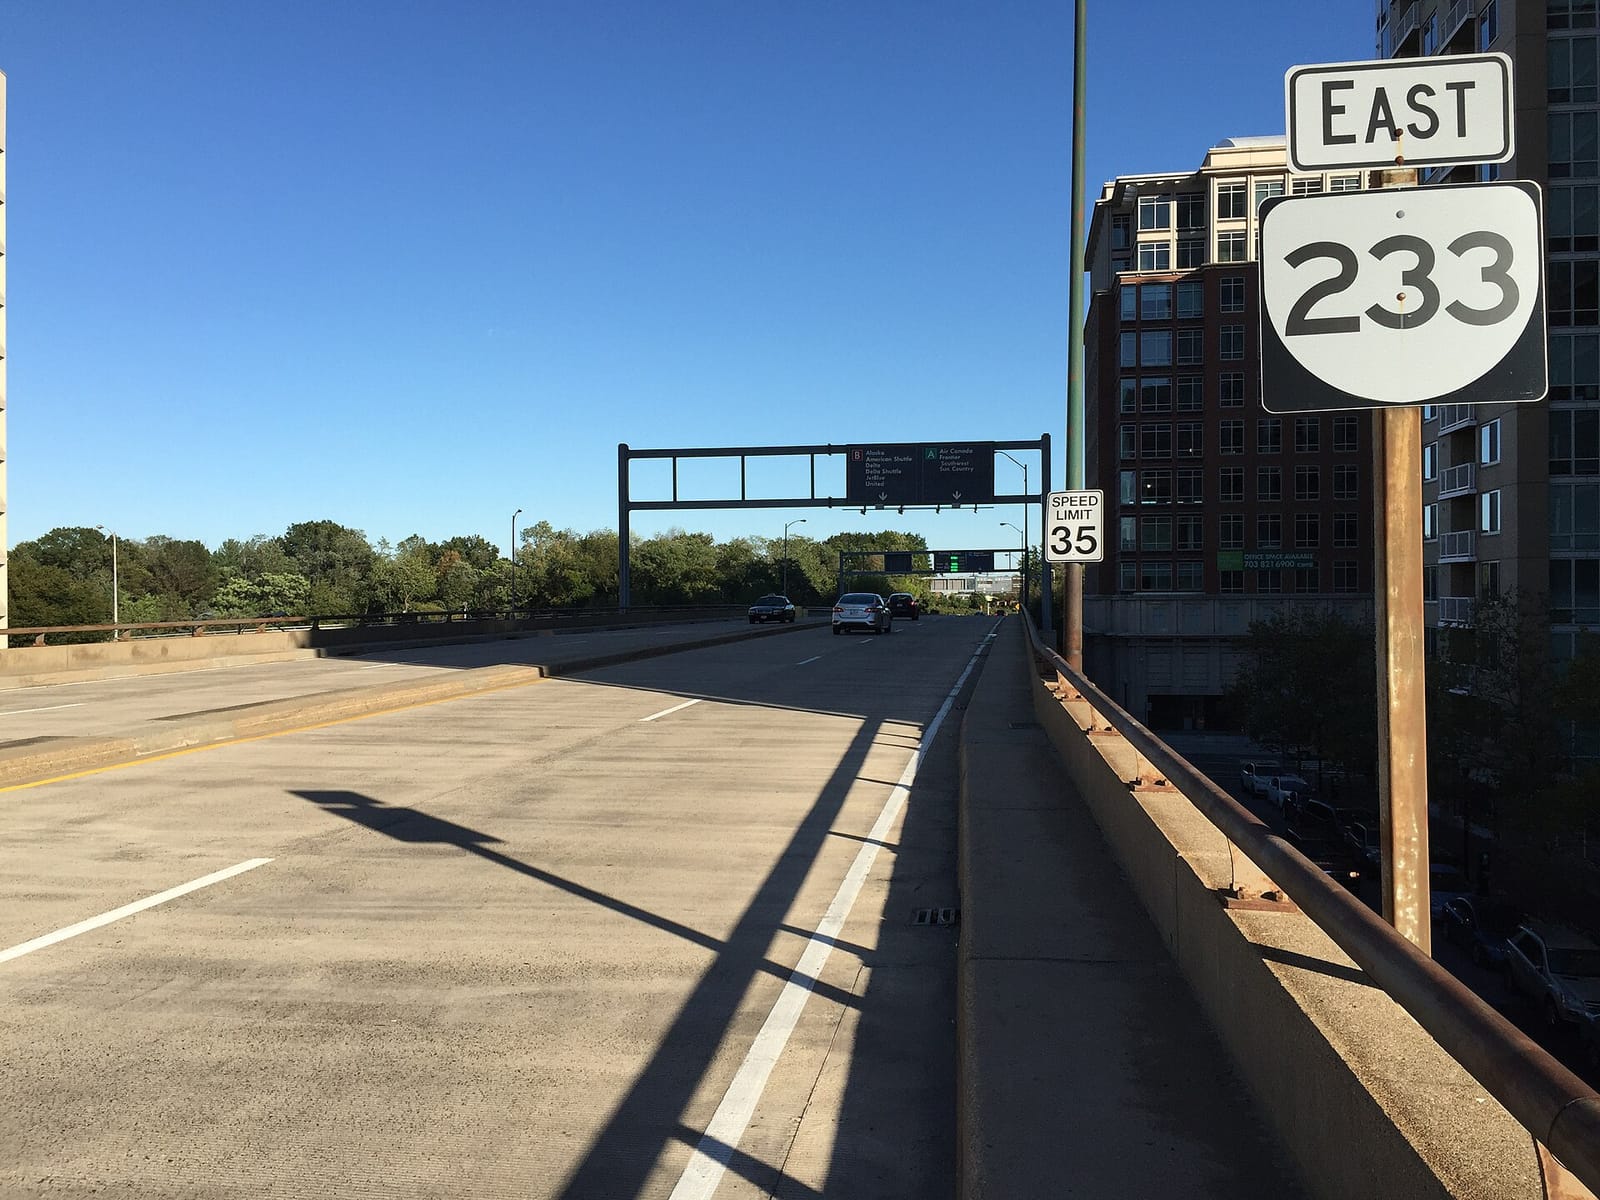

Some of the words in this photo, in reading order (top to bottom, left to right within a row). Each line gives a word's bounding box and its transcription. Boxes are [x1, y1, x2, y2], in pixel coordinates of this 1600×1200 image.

[1322, 80, 1475, 145] EAST
[1283, 230, 1519, 336] 233
[854, 451, 861, 460] B
[927, 450, 935, 458] A
[1052, 495, 1098, 507] SPEED
[1056, 509, 1093, 521] LIMIT
[1050, 526, 1097, 555] 35
[1243, 560, 1258, 568] 703
[1260, 560, 1274, 568] 821
[1275, 560, 1295, 568] 6900
